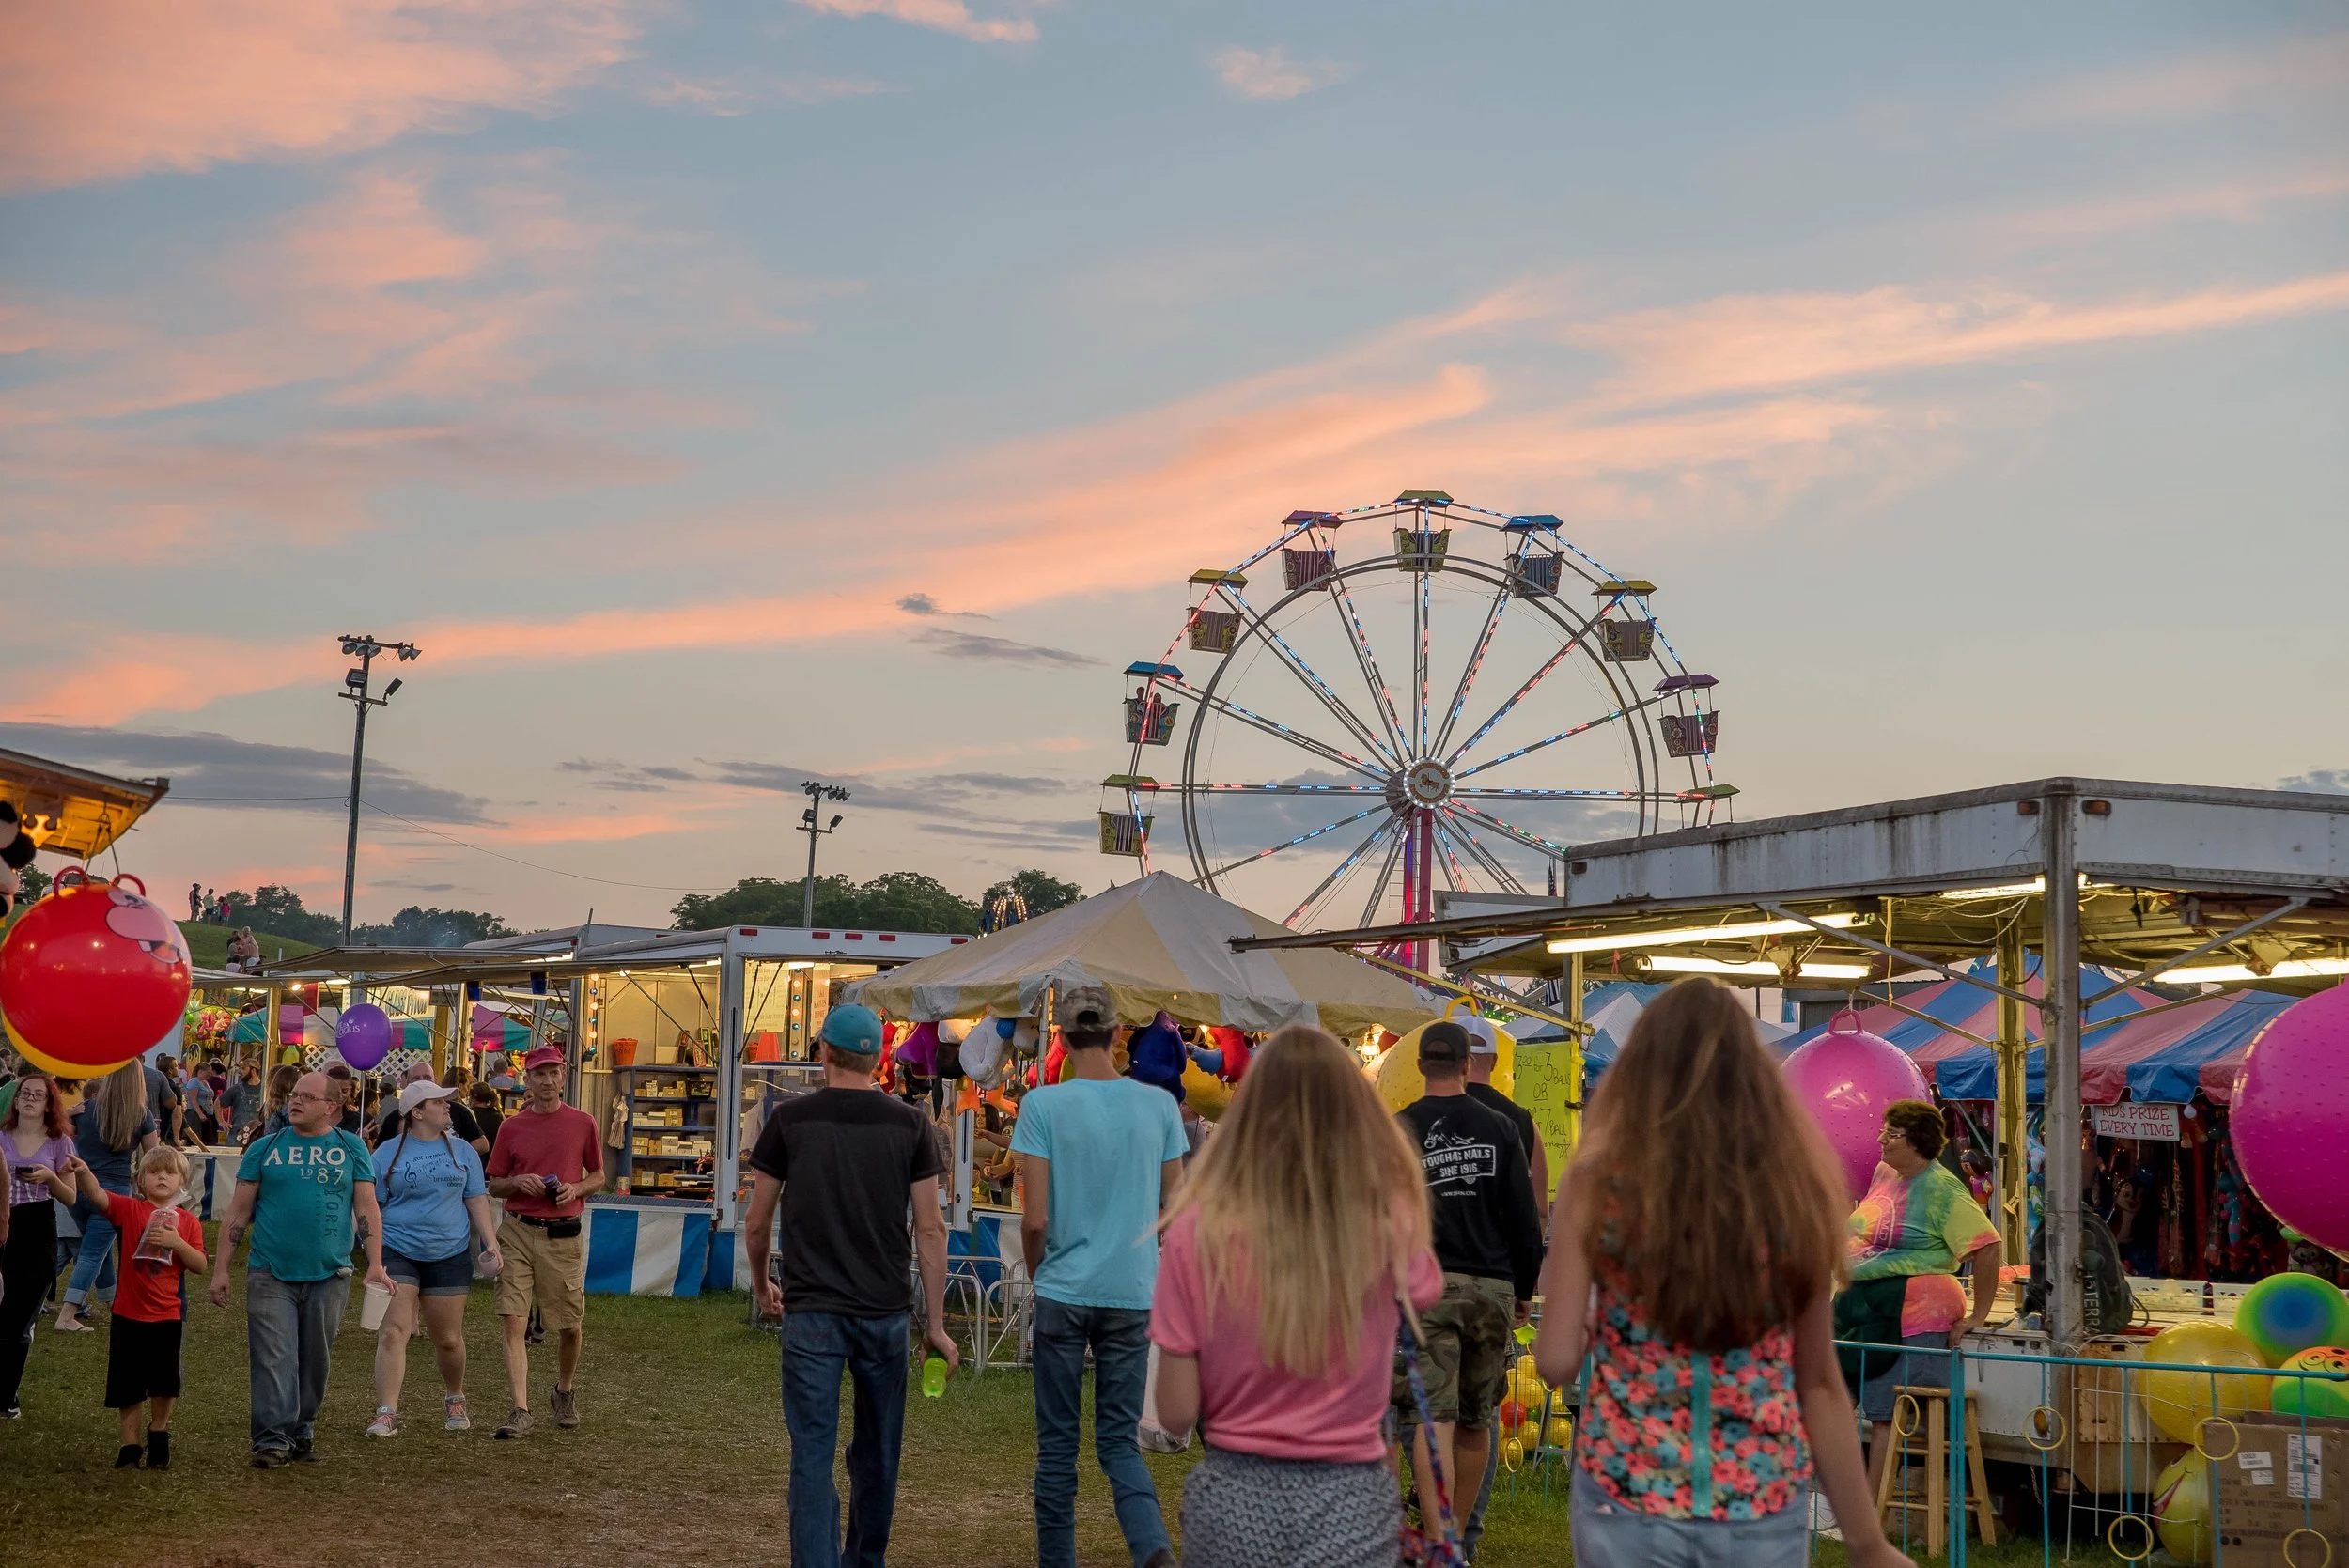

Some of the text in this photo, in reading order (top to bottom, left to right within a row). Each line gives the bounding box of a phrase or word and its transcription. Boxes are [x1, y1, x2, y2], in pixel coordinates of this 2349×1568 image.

[1533, 1082, 1548, 1100] OR
[2102, 1105, 2170, 1120] KIDS PRIZE
[2099, 1119, 2175, 1136] EVERY TIME
[263, 1145, 347, 1166] AERO
[1421, 1152, 1453, 1168] TOUGH
[1460, 1162, 1478, 1174] 1916
[323, 1185, 347, 1237] YORK
